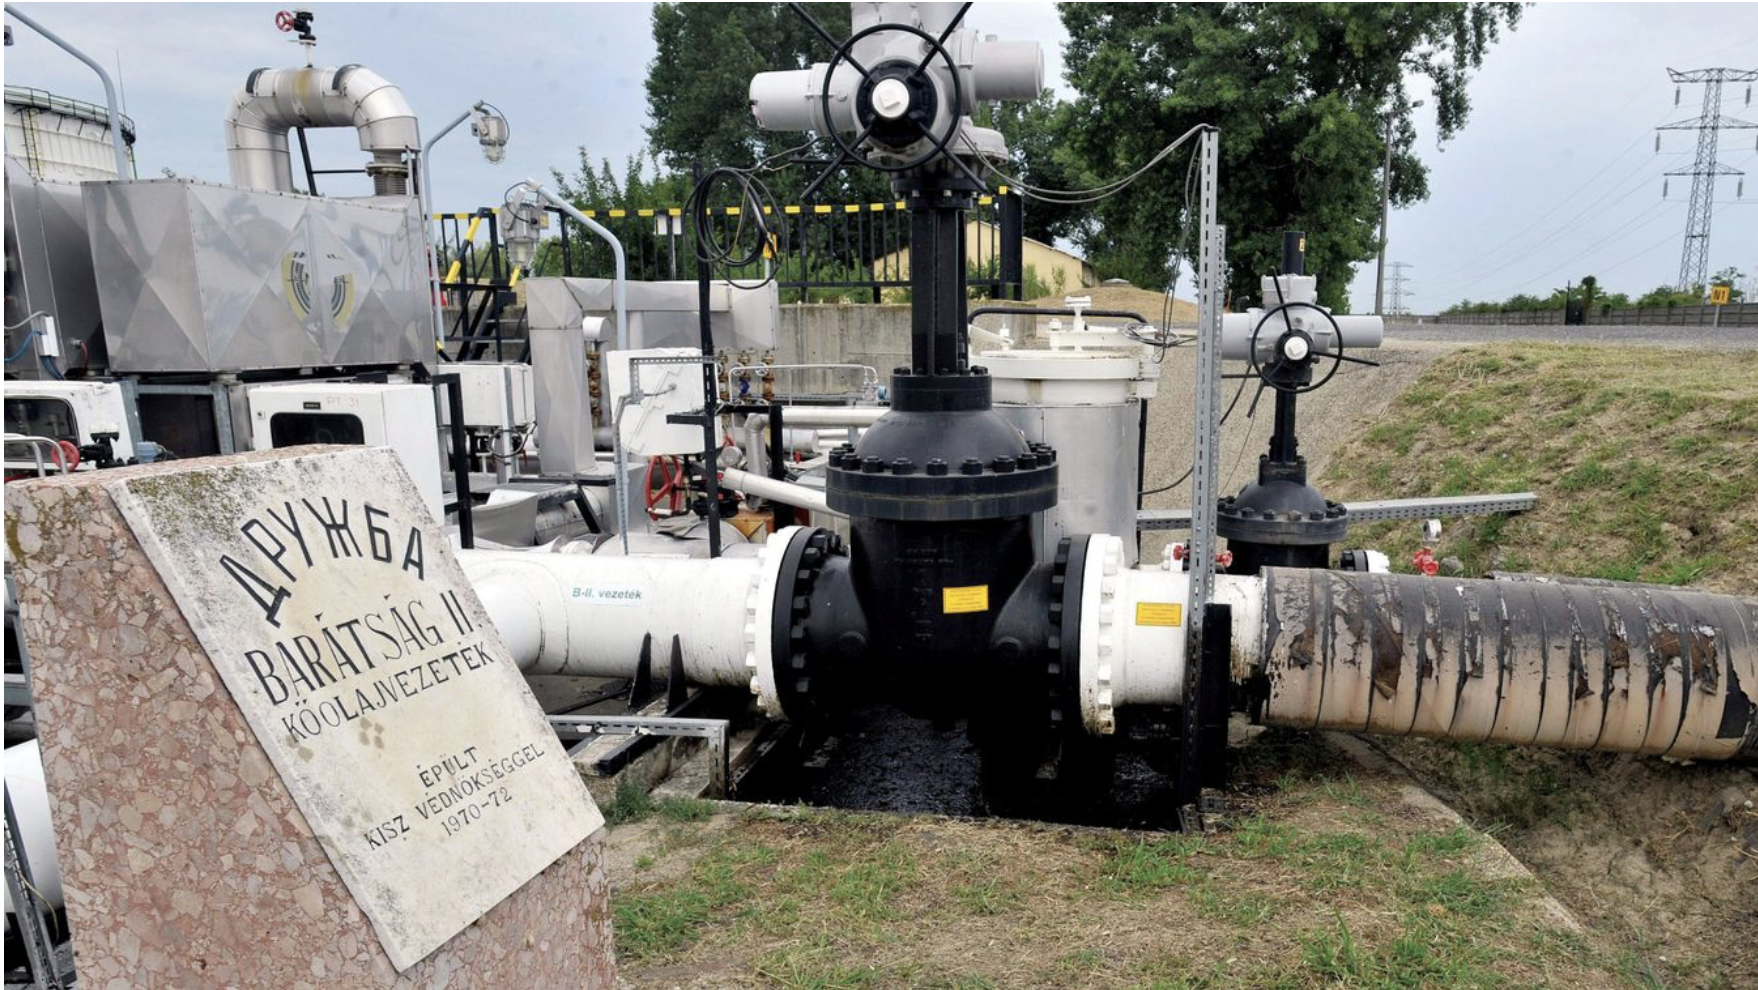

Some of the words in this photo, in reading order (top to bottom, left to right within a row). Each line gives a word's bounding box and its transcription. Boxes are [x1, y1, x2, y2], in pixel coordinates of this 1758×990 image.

[219, 496, 424, 629] ДРУЖБА
[244, 593, 444, 706] BARÁTSÁG
[416, 746, 477, 788] ÉPÜLT
[364, 814, 410, 850] KISZ
[441, 786, 513, 837] 1970-72
